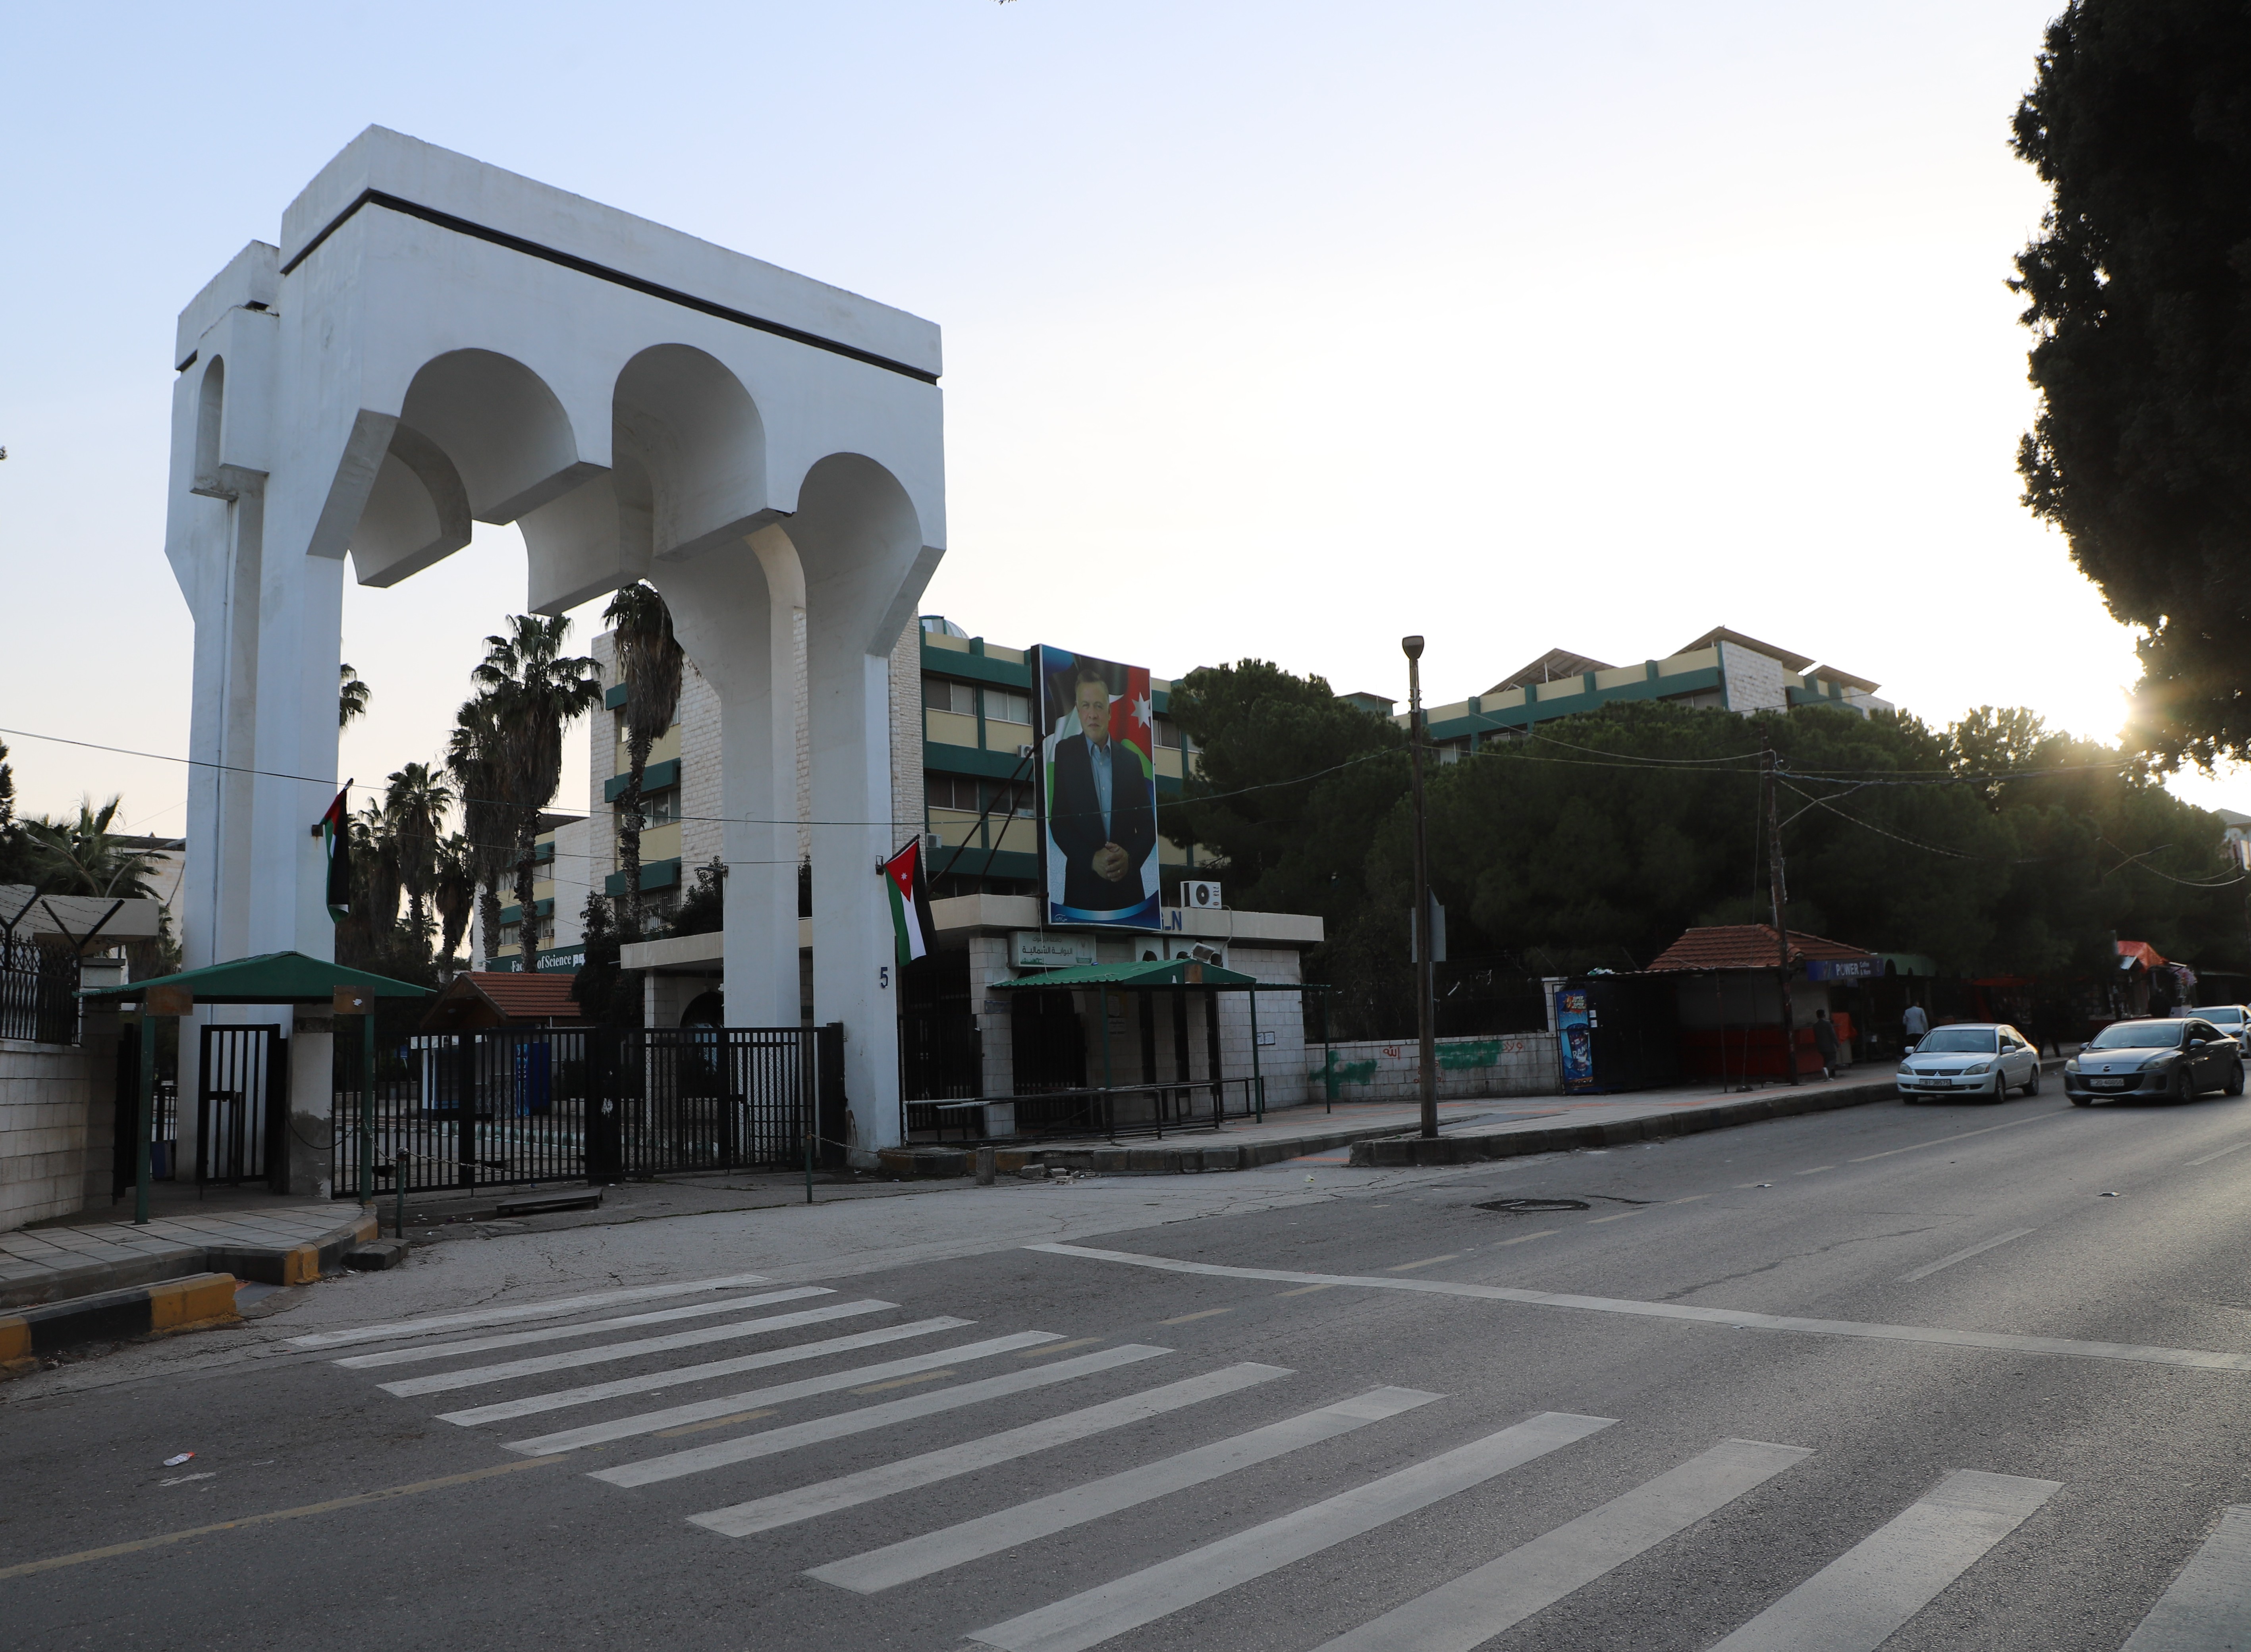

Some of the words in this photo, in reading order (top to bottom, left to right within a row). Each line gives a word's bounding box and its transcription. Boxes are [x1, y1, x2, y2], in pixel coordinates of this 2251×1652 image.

[1022, 946, 1051, 955] الشمالية
[1051, 947, 1073, 956] البوابة
[537, 955, 545, 969] of
[545, 954, 572, 968] Science
[1836, 963, 1859, 976] POWER
[880, 967, 888, 988] 5
[1383, 1045, 1400, 1060] الله
